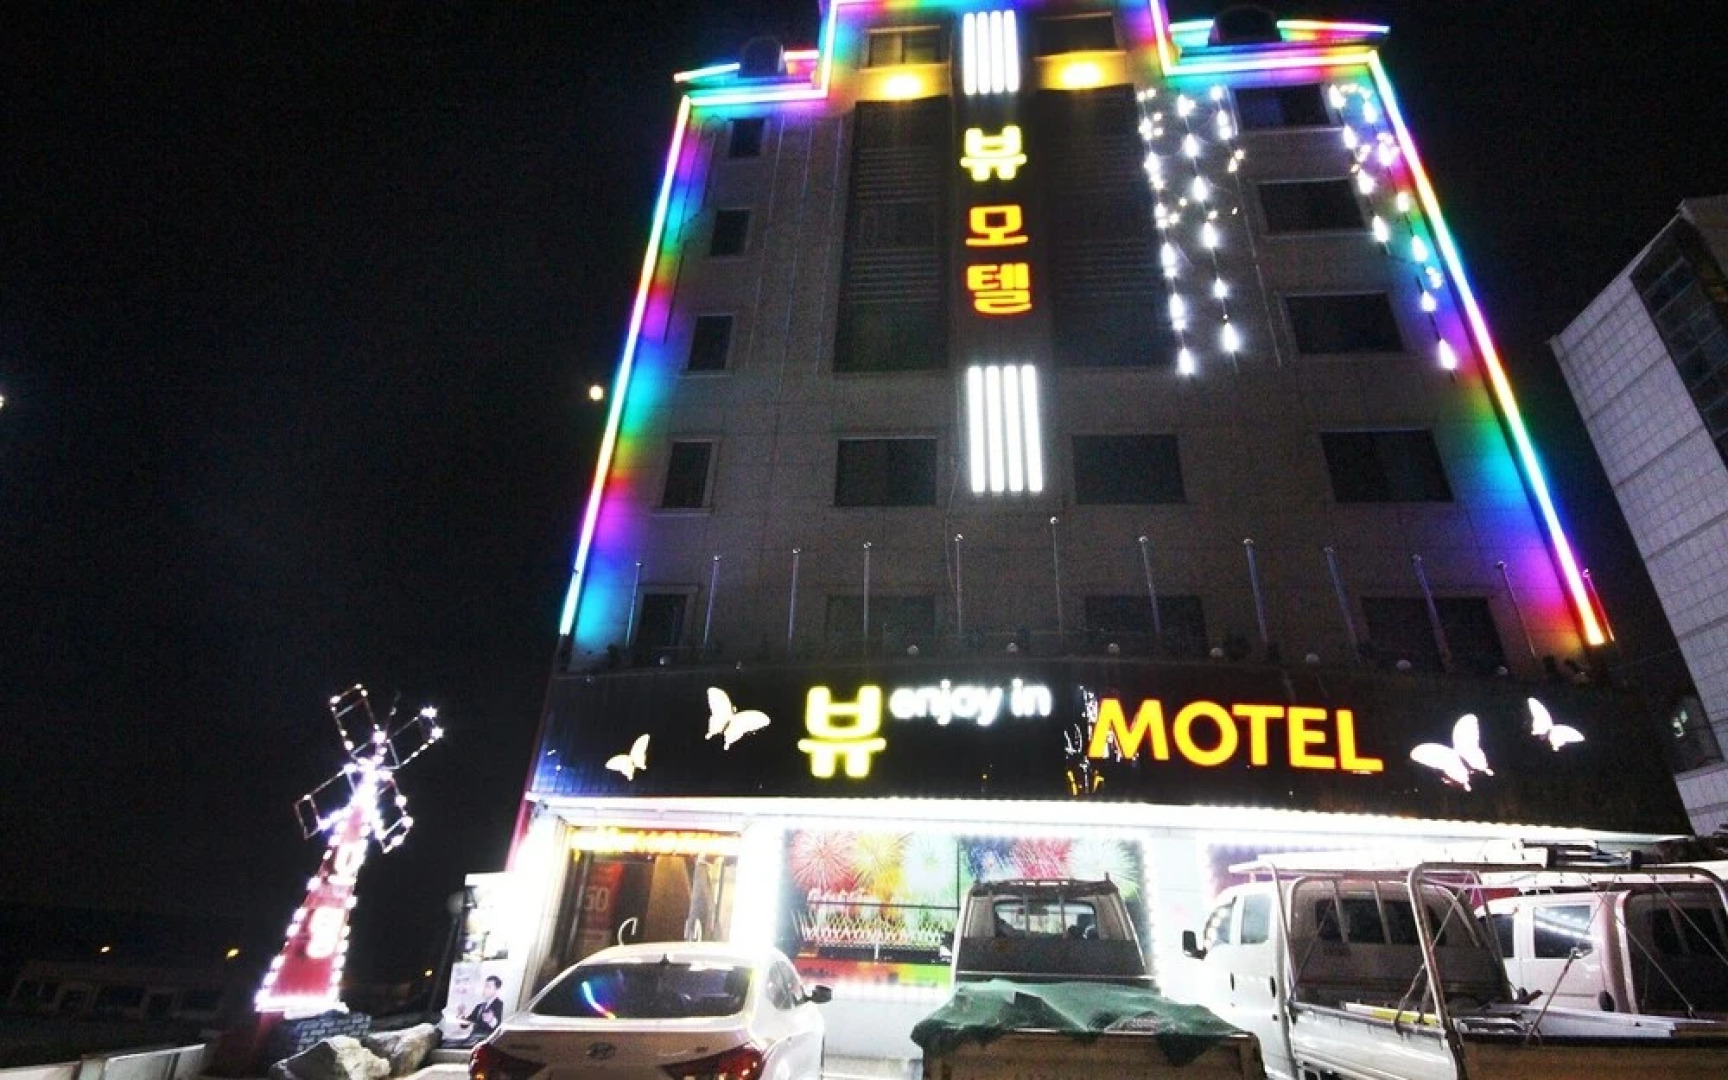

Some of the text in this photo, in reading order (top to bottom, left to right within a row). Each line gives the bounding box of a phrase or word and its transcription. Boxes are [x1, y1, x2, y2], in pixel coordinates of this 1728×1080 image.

[961, 125, 1032, 314] 뷰 모텔
[798, 685, 887, 779] 뷰
[889, 678, 1051, 726] enjoy in
[1088, 698, 1384, 772] MOTEL
